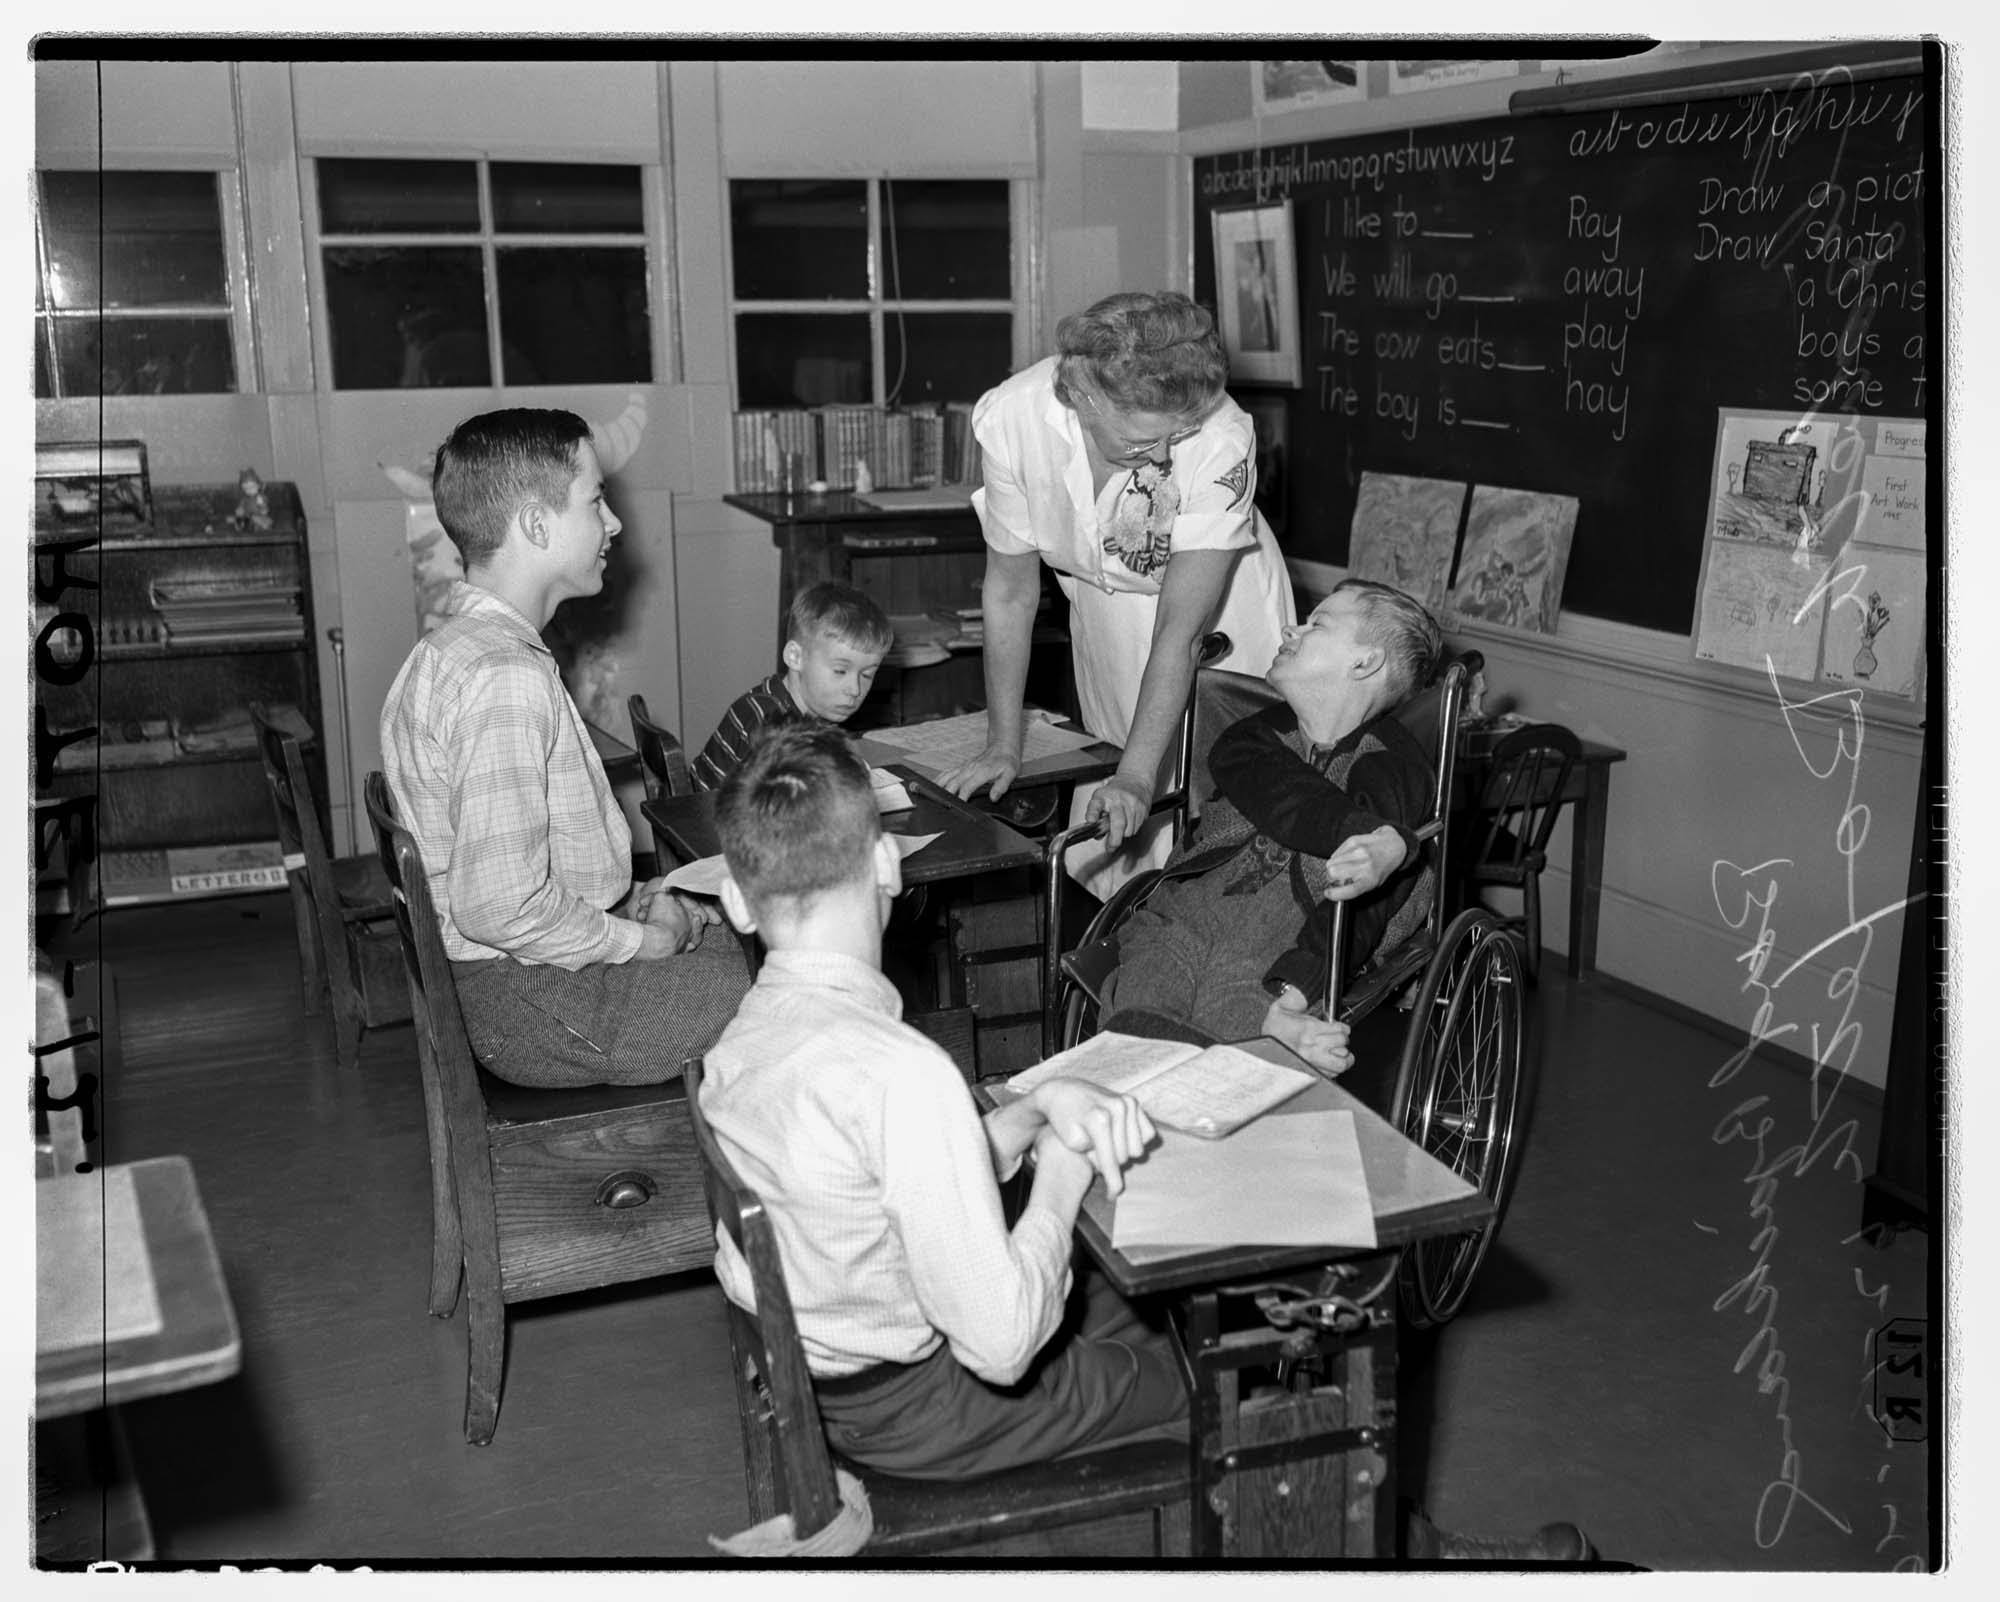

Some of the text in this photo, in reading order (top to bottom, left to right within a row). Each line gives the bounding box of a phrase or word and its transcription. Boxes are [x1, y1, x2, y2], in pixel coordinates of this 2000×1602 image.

[1343, 195, 1382, 239] like
[1392, 193, 1418, 239] to
[1698, 177, 1785, 215] Draw
[1807, 181, 1831, 209] a
[1568, 195, 1622, 263] Ray
[1694, 212, 1896, 264] Draw Santa
[1323, 252, 1458, 321] We will go
[1563, 266, 1645, 321] away
[1796, 264, 1926, 311] a Chris
[1318, 311, 1498, 371] The cow eats
[1563, 302, 1630, 377] play
[1797, 312, 1882, 376] boys
[1317, 365, 1457, 441] The boy is
[1565, 361, 1630, 441] hay
[1793, 376, 1884, 408] some
